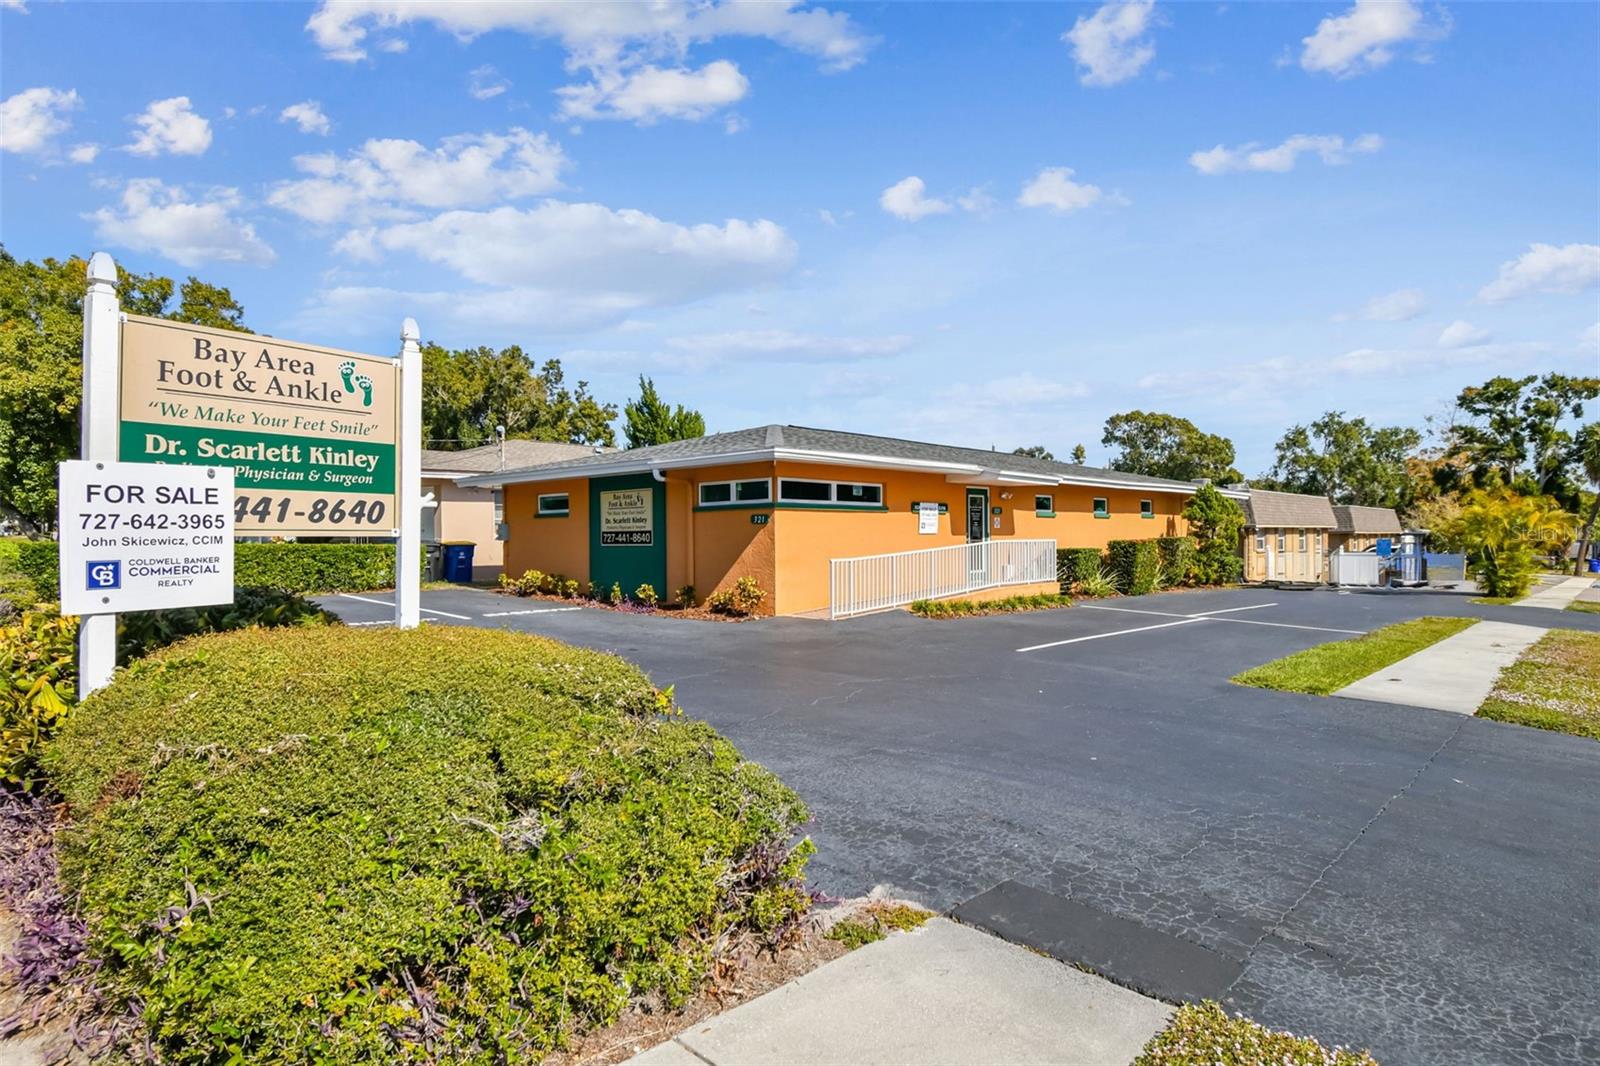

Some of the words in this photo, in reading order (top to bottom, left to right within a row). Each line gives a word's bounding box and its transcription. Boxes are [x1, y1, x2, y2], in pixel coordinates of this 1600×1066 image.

[193, 337, 246, 372] Bay
[254, 349, 315, 376] Area
[157, 360, 223, 389] Foot
[232, 371, 256, 393] &
[265, 376, 342, 403] Ankle
[193, 405, 245, 424] Make
[251, 411, 289, 428] Your
[293, 416, 326, 431] Feet
[144, 433, 187, 456] Dr.
[197, 438, 302, 464] Scarlett
[309, 446, 380, 472] Kinley
[234, 465, 304, 482] Physician
[308, 469, 320, 481] &
[323, 471, 373, 486] Surgeon
[86, 484, 145, 504] FOR
[155, 486, 219, 505] SALE
[79, 513, 225, 530] 727-642-3965
[81, 536, 117, 547] John
[121, 536, 189, 547] Skicewicz,
[192, 535, 224, 545] CCIM
[603, 532, 651, 543] 727-441-8640
[128, 557, 181, 567] COLDWELL
[184, 556, 220, 565] BANKER
[128, 564, 220, 577] COMMERCIAL
[158, 578, 194, 588] REALTY
